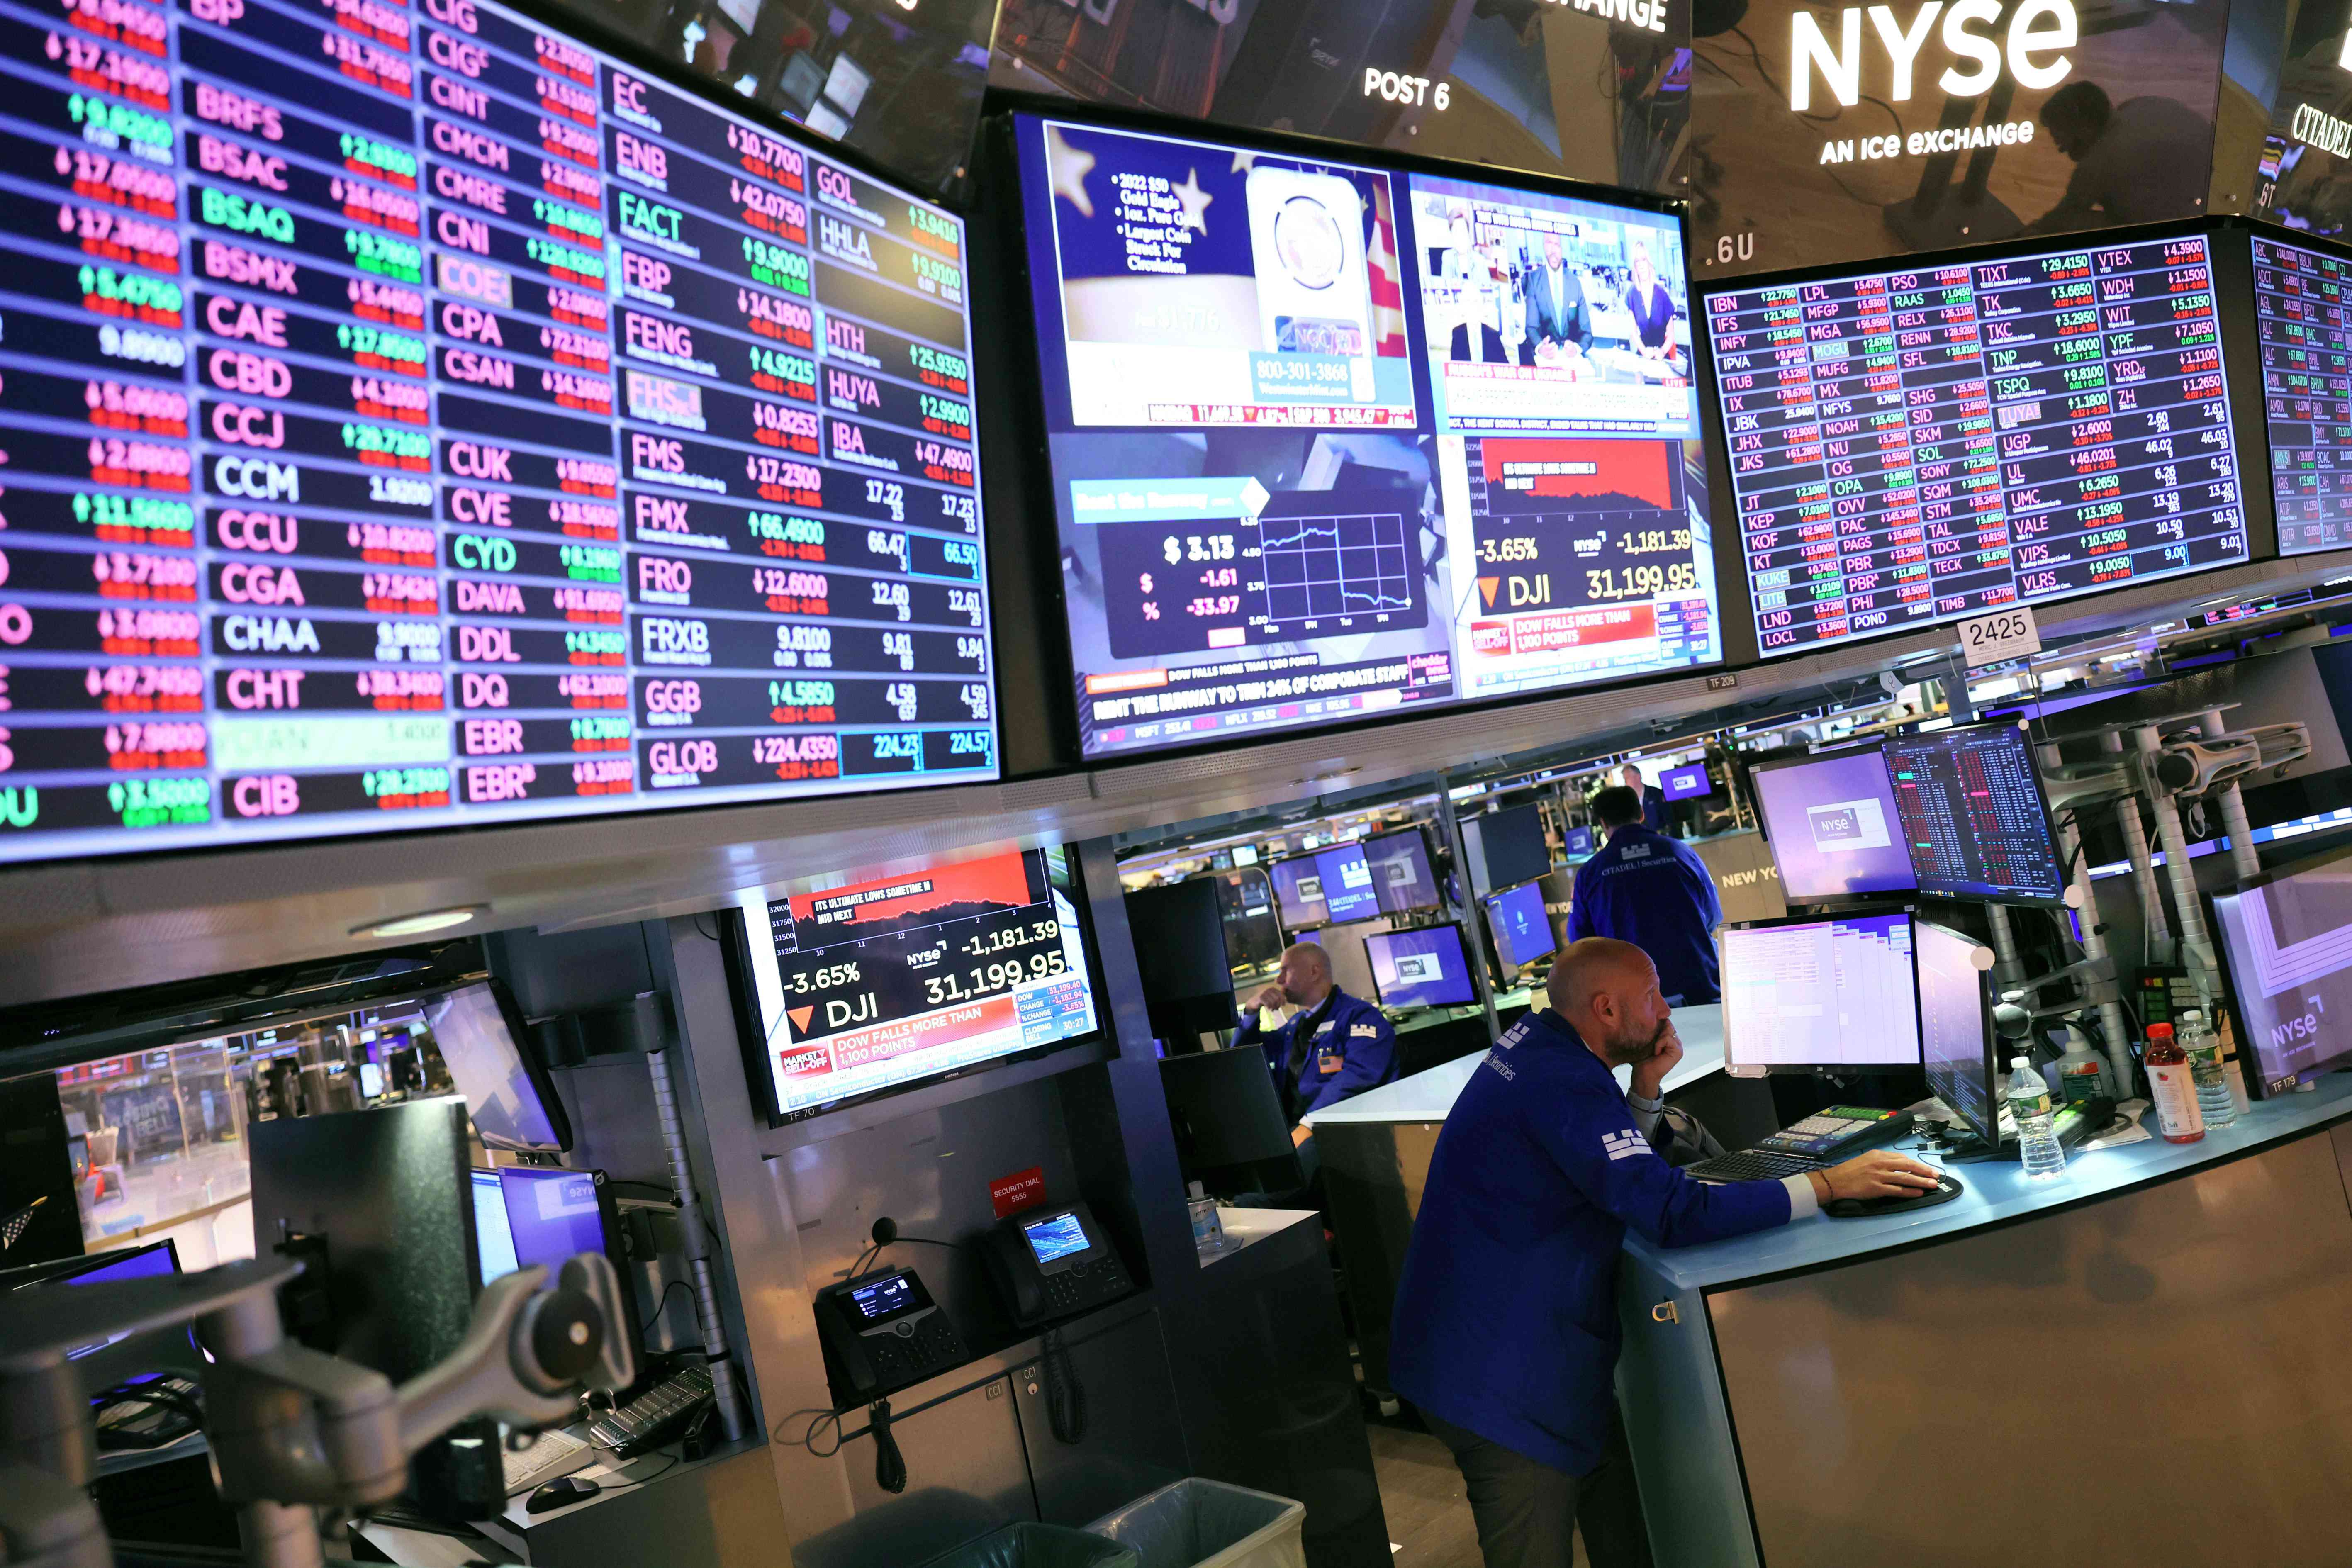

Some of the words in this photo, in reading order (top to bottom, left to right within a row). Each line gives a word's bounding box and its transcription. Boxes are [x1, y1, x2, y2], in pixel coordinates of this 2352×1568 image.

[1364, 67, 1430, 106] POST
[1434, 82, 1450, 111] 6
[196, 82, 284, 141] BRFS
[2291, 103, 2352, 159] CITADEL
[1820, 139, 1854, 165] AN
[616, 132, 667, 179] ENB
[742, 184, 806, 228] 42.0750
[202, 187, 295, 243] BSAQ
[619, 192, 683, 241] FACT
[1718, 233, 1753, 263] 6U
[2098, 250, 2132, 267] VTEX
[2171, 241, 2203, 256] 4.3900
[2255, 243, 2266, 257] ABC
[1978, 265, 2007, 282] TIXT
[2049, 255, 2088, 271] 29.4150
[2258, 269, 2271, 283] ADCT
[1714, 297, 1738, 312] IBN
[1895, 294, 1924, 307] RAAS
[207, 295, 288, 348] CAE
[443, 303, 503, 347] CPA
[626, 312, 693, 358] FENG
[762, 350, 816, 385] 4.9215
[2109, 334, 2133, 349] YPF
[1257, 360, 1348, 382] 800-301-3868
[1817, 363, 1848, 377] MUFG
[829, 369, 881, 408] HUYA
[1666, 379, 1684, 387] LIVE
[1727, 375, 1753, 390] ITUB
[1995, 377, 2030, 393] TSPQ
[2311, 377, 2323, 390] BHVN
[2270, 399, 2284, 412] AMRX
[2145, 439, 2172, 453] 46.02
[449, 441, 513, 482] CUK
[2317, 451, 2330, 463] BOAC
[215, 455, 299, 502] CCM
[1921, 464, 1950, 479] SONY
[1835, 480, 1863, 494] OPA
[2208, 482, 2234, 497] 13.20
[1748, 514, 1775, 530] KEP
[2015, 516, 2048, 535] VALE
[1164, 536, 1181, 565] $
[1187, 535, 1235, 560] 3.13
[1476, 538, 1537, 562] -3.65%
[1617, 529, 1691, 555] -1,181.39
[455, 534, 517, 572] CYD
[1242, 548, 1261, 558] 4.50
[2018, 545, 2048, 562] VIPS
[639, 557, 691, 592] FRO
[765, 570, 828, 598] 12.6000
[1140, 573, 1153, 594] $
[1200, 568, 1238, 587] -1.61
[1508, 574, 1550, 606] DJI
[1586, 563, 1696, 600] 31,199.95
[1142, 602, 1160, 620] %
[1186, 596, 1240, 616] -33.97
[1517, 620, 1542, 634] DOW
[1544, 616, 1574, 631] FALLS
[1576, 613, 1604, 626] MORE
[1605, 610, 1630, 622] THAN
[1855, 613, 1887, 628] POND
[1970, 615, 2026, 645] 2425
[1517, 634, 1541, 649] 1,100
[1543, 631, 1579, 645] POINTS
[1169, 669, 1191, 682] DOW
[1192, 666, 1218, 678] FALLS
[1219, 663, 1244, 675] MORE
[1245, 660, 1268, 672] THAN
[1412, 655, 1447, 668] cheddar
[1426, 665, 1449, 676] news
[1710, 678, 1720, 688] TF
[1721, 676, 1734, 687] 209
[950, 732, 990, 755] 224.57
[649, 740, 718, 773] GLOB
[234, 775, 300, 817] CIB
[1602, 862, 1637, 877] CITADEL
[1641, 857, 1676, 867] Securities
[1722, 869, 1756, 888] NEW
[815, 901, 828, 911] ITS
[828, 894, 864, 908] ULTIMATE
[865, 890, 885, 901] LOWS
[886, 883, 922, 898] SOMETIME
[923, 881, 931, 891] M
[769, 905, 789, 913] 32000
[817, 914, 833, 925] MID
[834, 909, 852, 921] NEXT
[772, 918, 792, 927] 31750
[774, 933, 794, 942] 31500
[962, 920, 1058, 955] -1,181.39
[777, 947, 797, 956] 31250
[784, 962, 861, 994] -3.65%
[826, 992, 878, 1027] DJI
[925, 950, 1065, 1004] 31,199.95
[1018, 993, 1032, 1002] DOW
[1049, 981, 1081, 995] 31,199.40
[1020, 1001, 1044, 1011] CHANGE
[1052, 991, 1082, 1004] -1,181.94
[1062, 1000, 1084, 1011] -3.65%
[837, 1035, 869, 1051] DOW
[872, 1025, 910, 1043] FALLS
[913, 1015, 947, 1033] MORE
[949, 1007, 981, 1024] THAN
[1025, 1023, 1052, 1035] CLOSING
[1063, 1018, 1083, 1030] 30:27
[784, 1050, 817, 1066] MARKET
[840, 1049, 868, 1066] 1,100
[872, 1037, 915, 1057] POINTS
[786, 1057, 827, 1075] SELL-OFF
[1488, 1056, 1516, 1081] Securities
[2272, 1081, 2282, 1092] TF
[2283, 1076, 2296, 1088] 179
[789, 1111, 800, 1121] TF
[803, 1108, 814, 1117] 70
[994, 1181, 1024, 1198] SECURITY
[1026, 1177, 1040, 1187] DIAL
[1012, 1192, 1026, 1202] 5555
[1025, 1366, 1035, 1379] CC1
